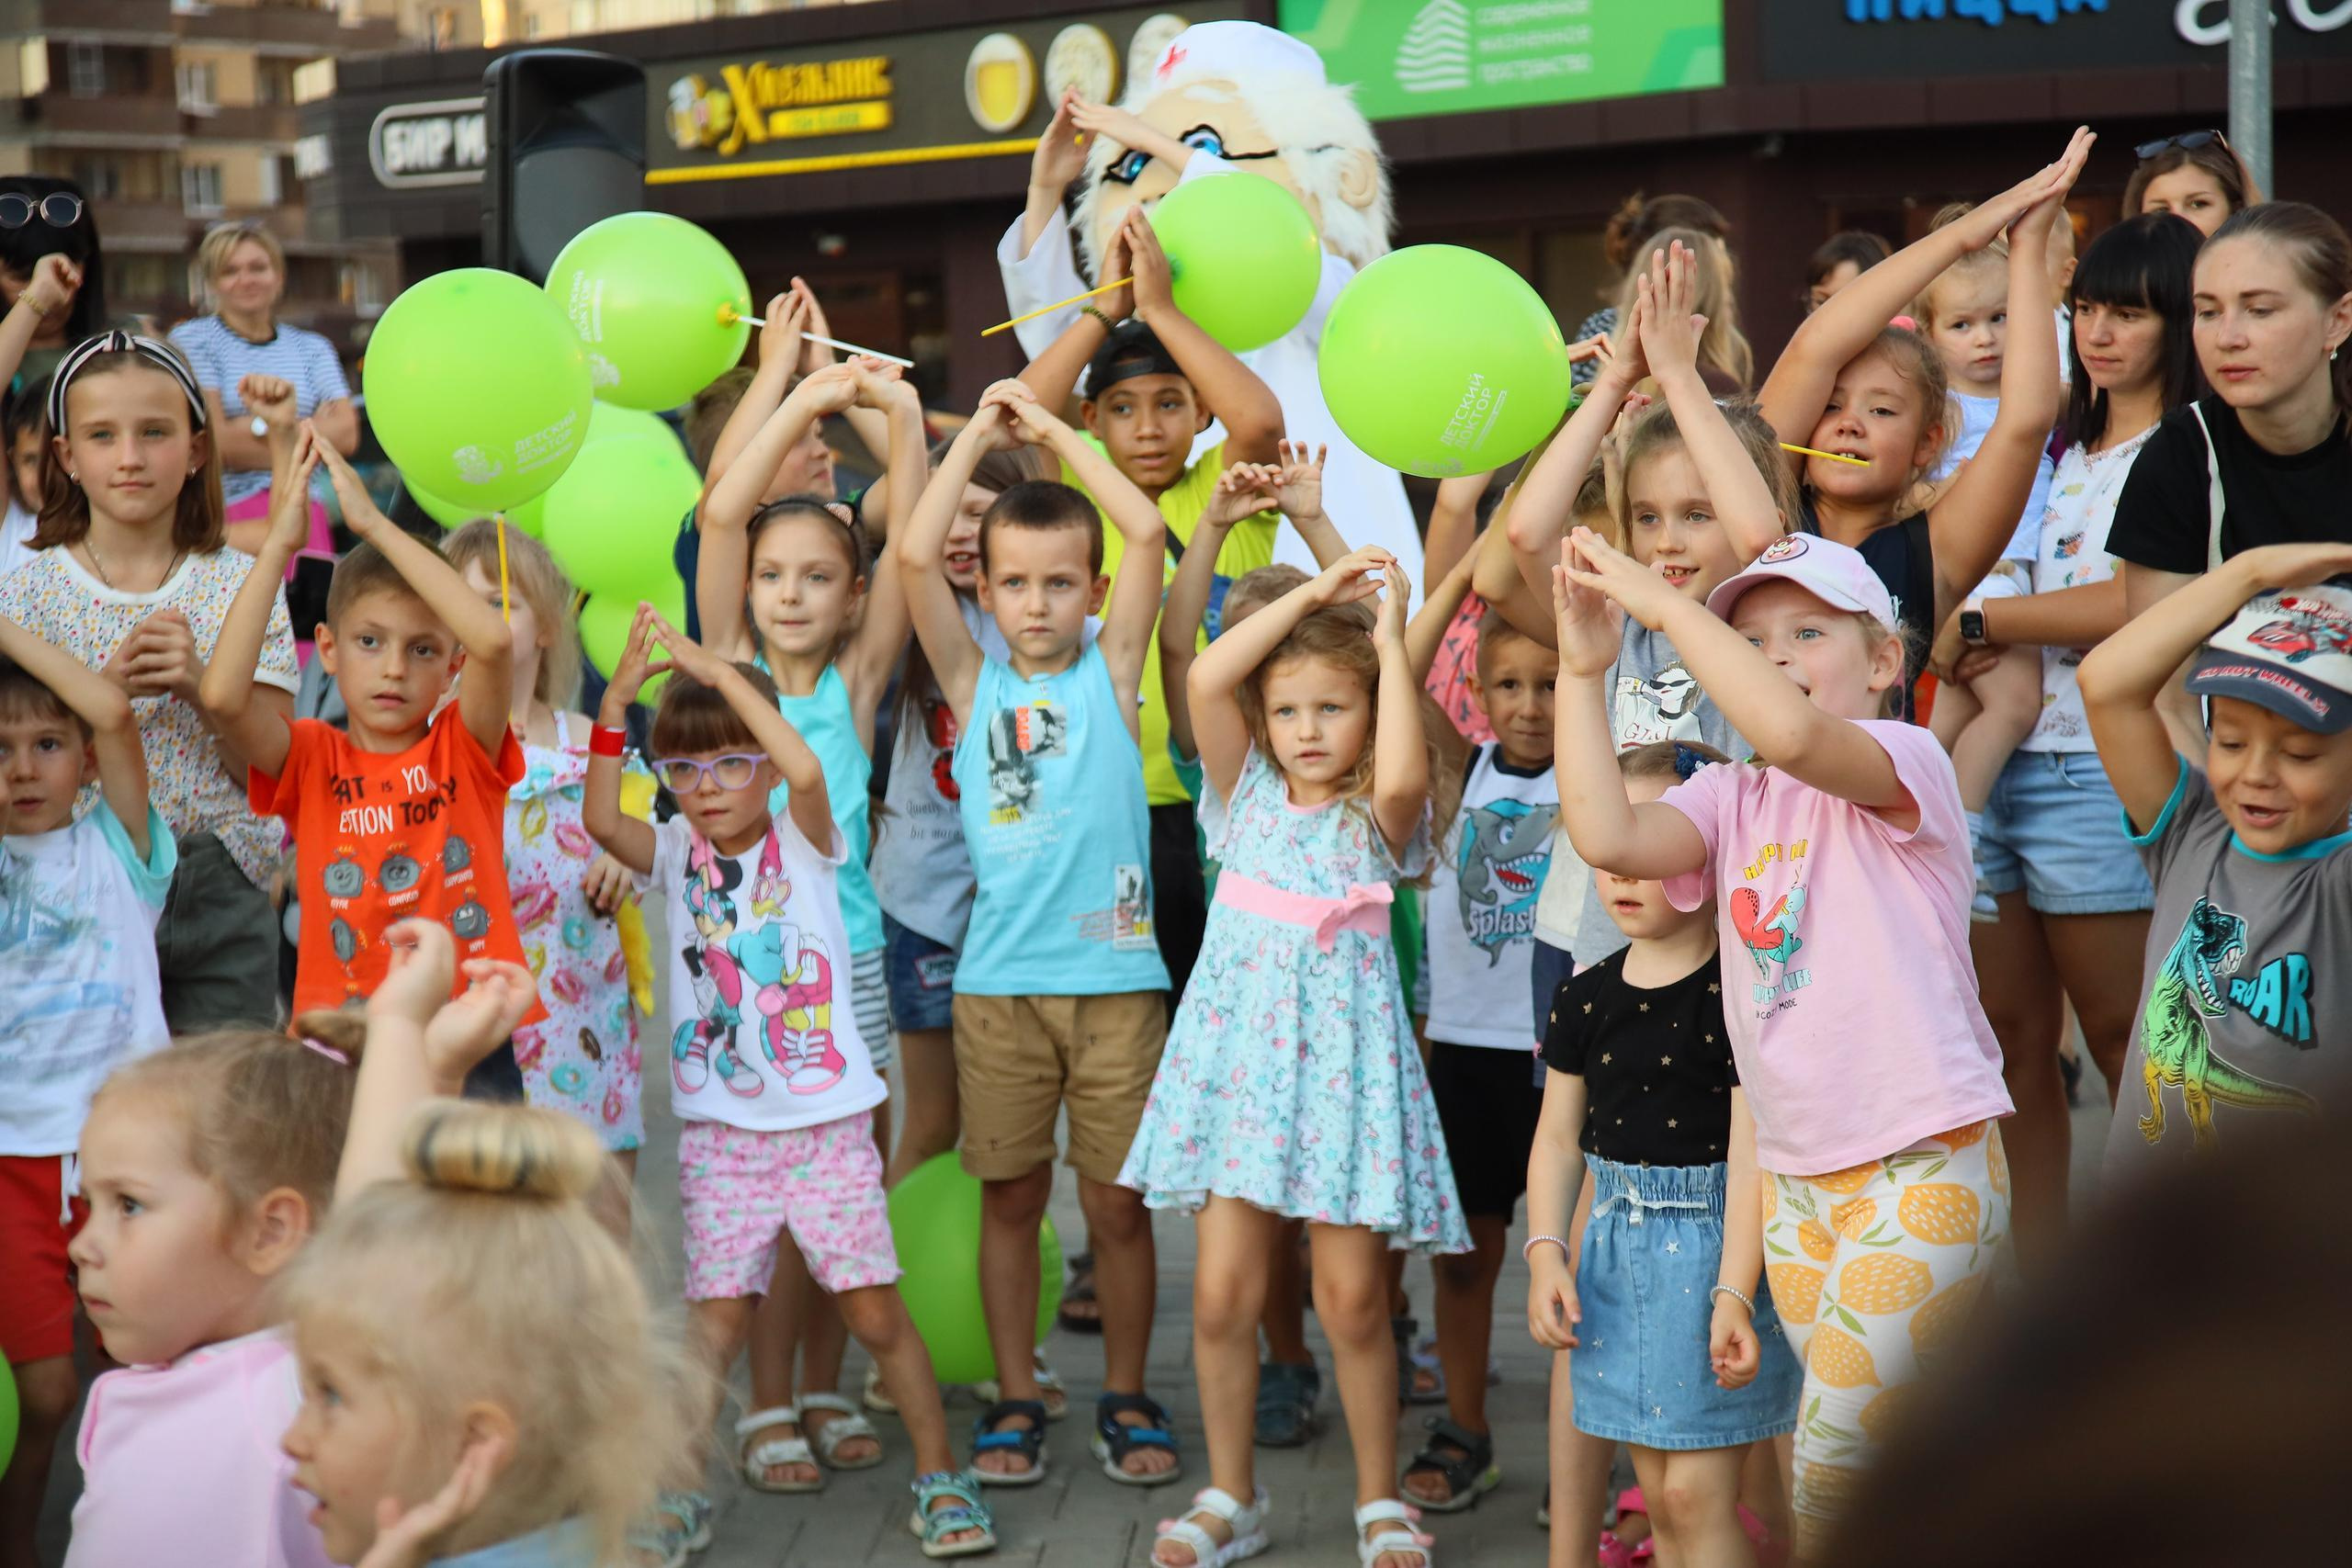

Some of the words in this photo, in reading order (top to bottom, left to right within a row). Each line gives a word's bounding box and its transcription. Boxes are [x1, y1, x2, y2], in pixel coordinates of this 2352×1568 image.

[1441, 372, 1485, 446] ДЕТСКИЙ
[1454, 387, 1491, 451] ДОКТОР
[514, 408, 577, 455] ДЕТСКИЙ
[516, 428, 572, 465] ДОКТОР
[401, 764, 437, 795] YO
[1742, 842, 1783, 881] HAPY
[1782, 968, 1812, 993] LIFE
[2228, 953, 2315, 1046] ROAR
[1779, 998, 1798, 1011] MODE
